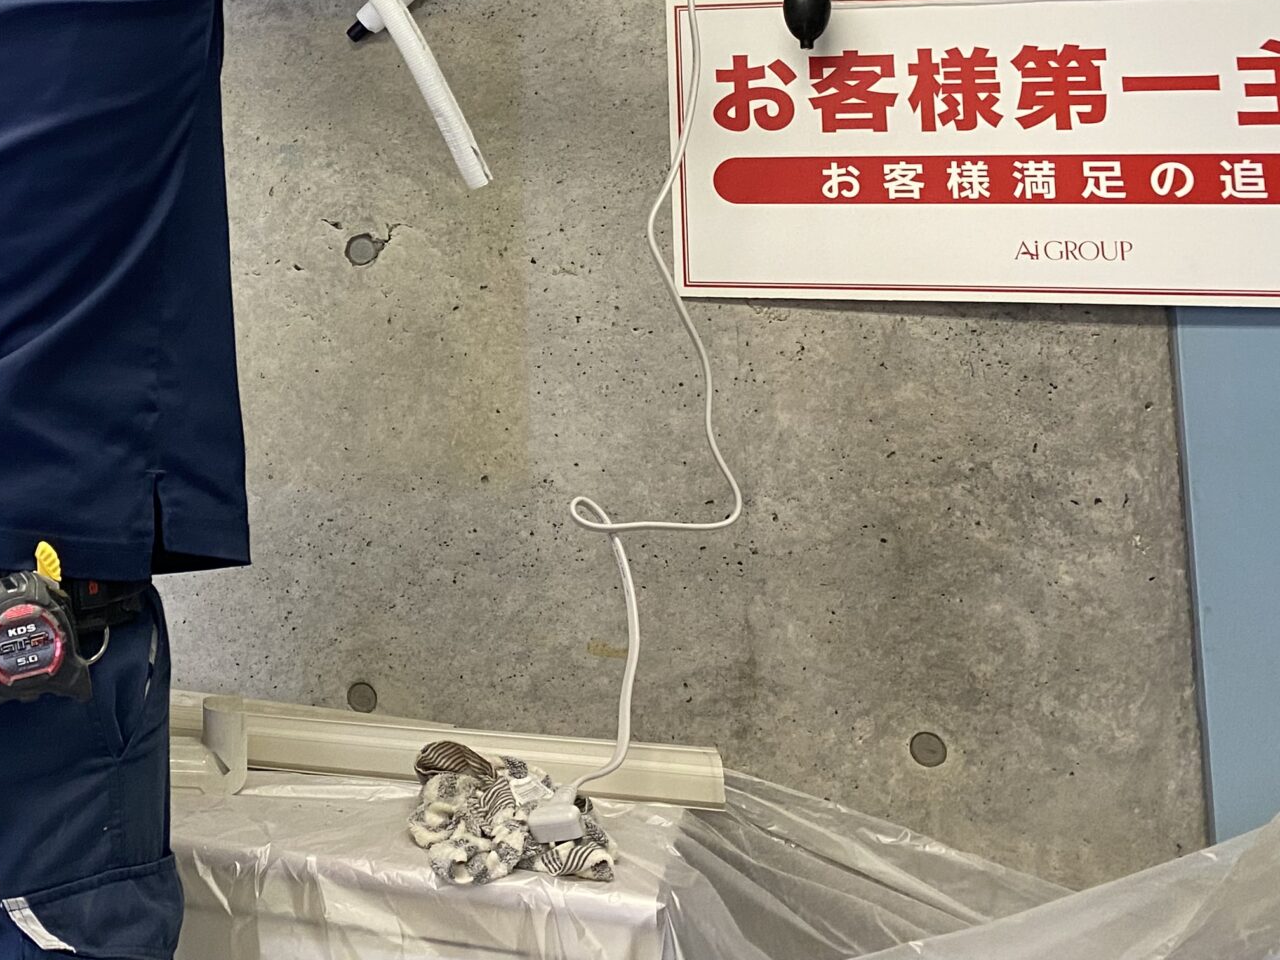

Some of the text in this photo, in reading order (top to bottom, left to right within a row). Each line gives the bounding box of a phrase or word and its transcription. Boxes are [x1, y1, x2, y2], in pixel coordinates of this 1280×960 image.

[821, 159, 1269, 201] お客様満足の追
[8, 623, 36, 637] KDS
[17, 654, 38, 666] 5.0
